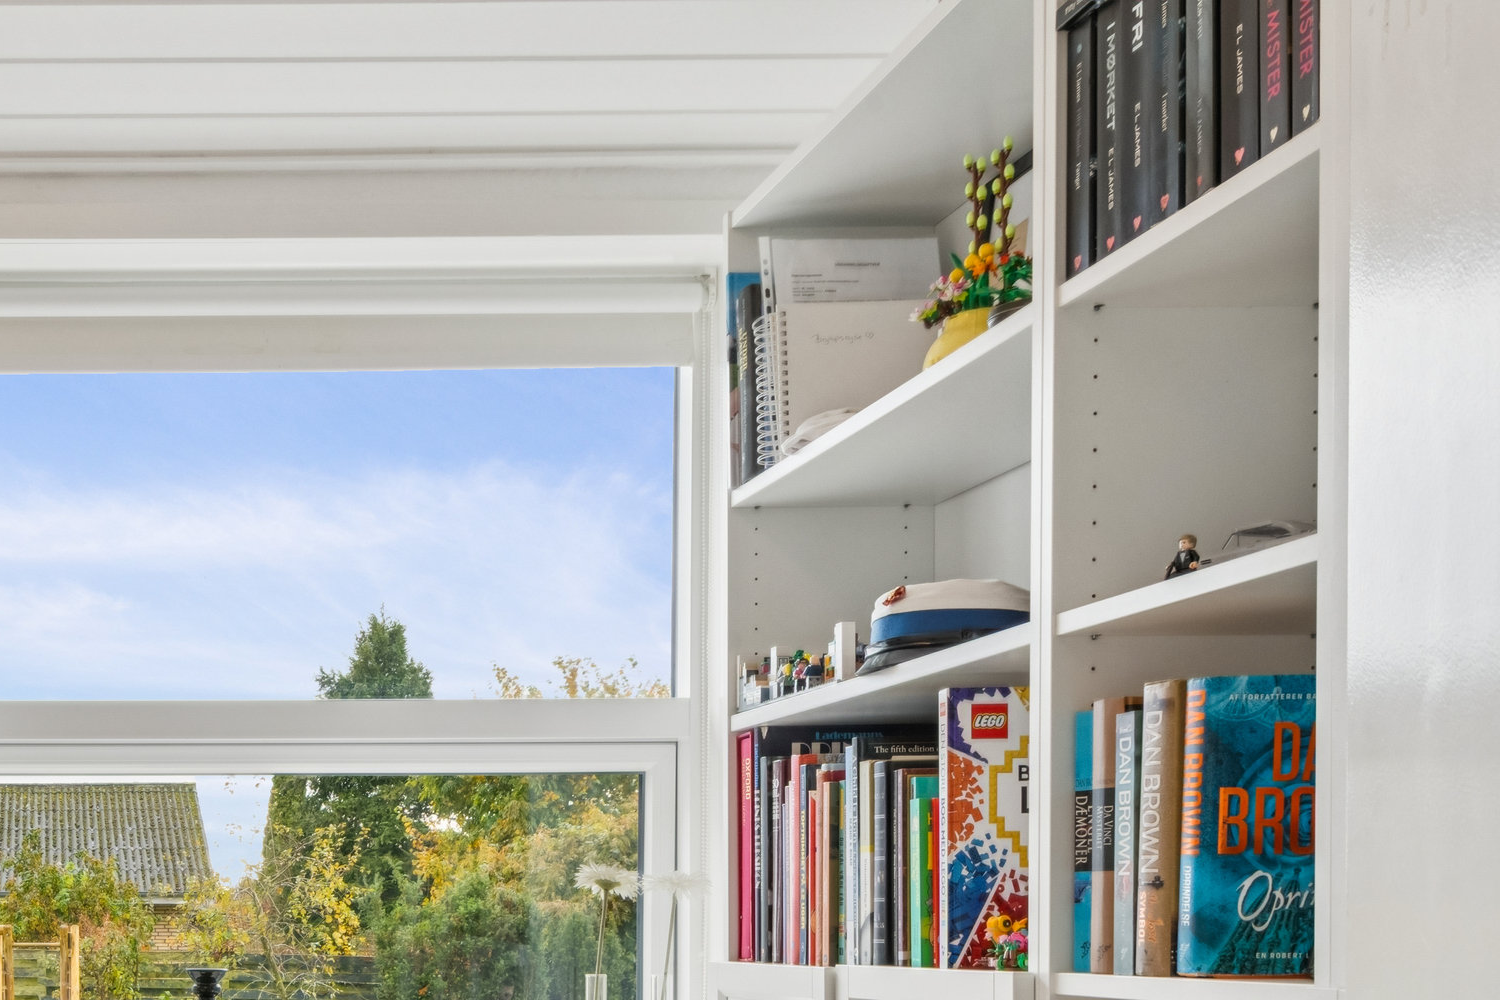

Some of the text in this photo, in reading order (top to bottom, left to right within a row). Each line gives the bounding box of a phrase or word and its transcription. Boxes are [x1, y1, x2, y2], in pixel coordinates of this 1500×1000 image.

[1131, 1, 1144, 53] FRI
[1106, 32, 1116, 130] MØRKET
[1235, 48, 1244, 94] JAMES
[1267, 9, 1281, 102] MISTER
[1107, 168, 1115, 210] JAMES
[974, 714, 1006, 728] LEGO
[1229, 693, 1303, 701] AF FORFATTEREN
[874, 743, 935, 754] The fifth edition
[1144, 710, 1163, 766] DAN
[1075, 795, 1088, 865] DÆMONER
[1103, 805, 1114, 846] DA VINCI
[1117, 736, 1132, 876] DAN BROWN
[1141, 774, 1161, 873] BROWN
[1181, 689, 1206, 927] DAN BROWN OPRINDELSE
[1138, 891, 1147, 945] SYMBOL
